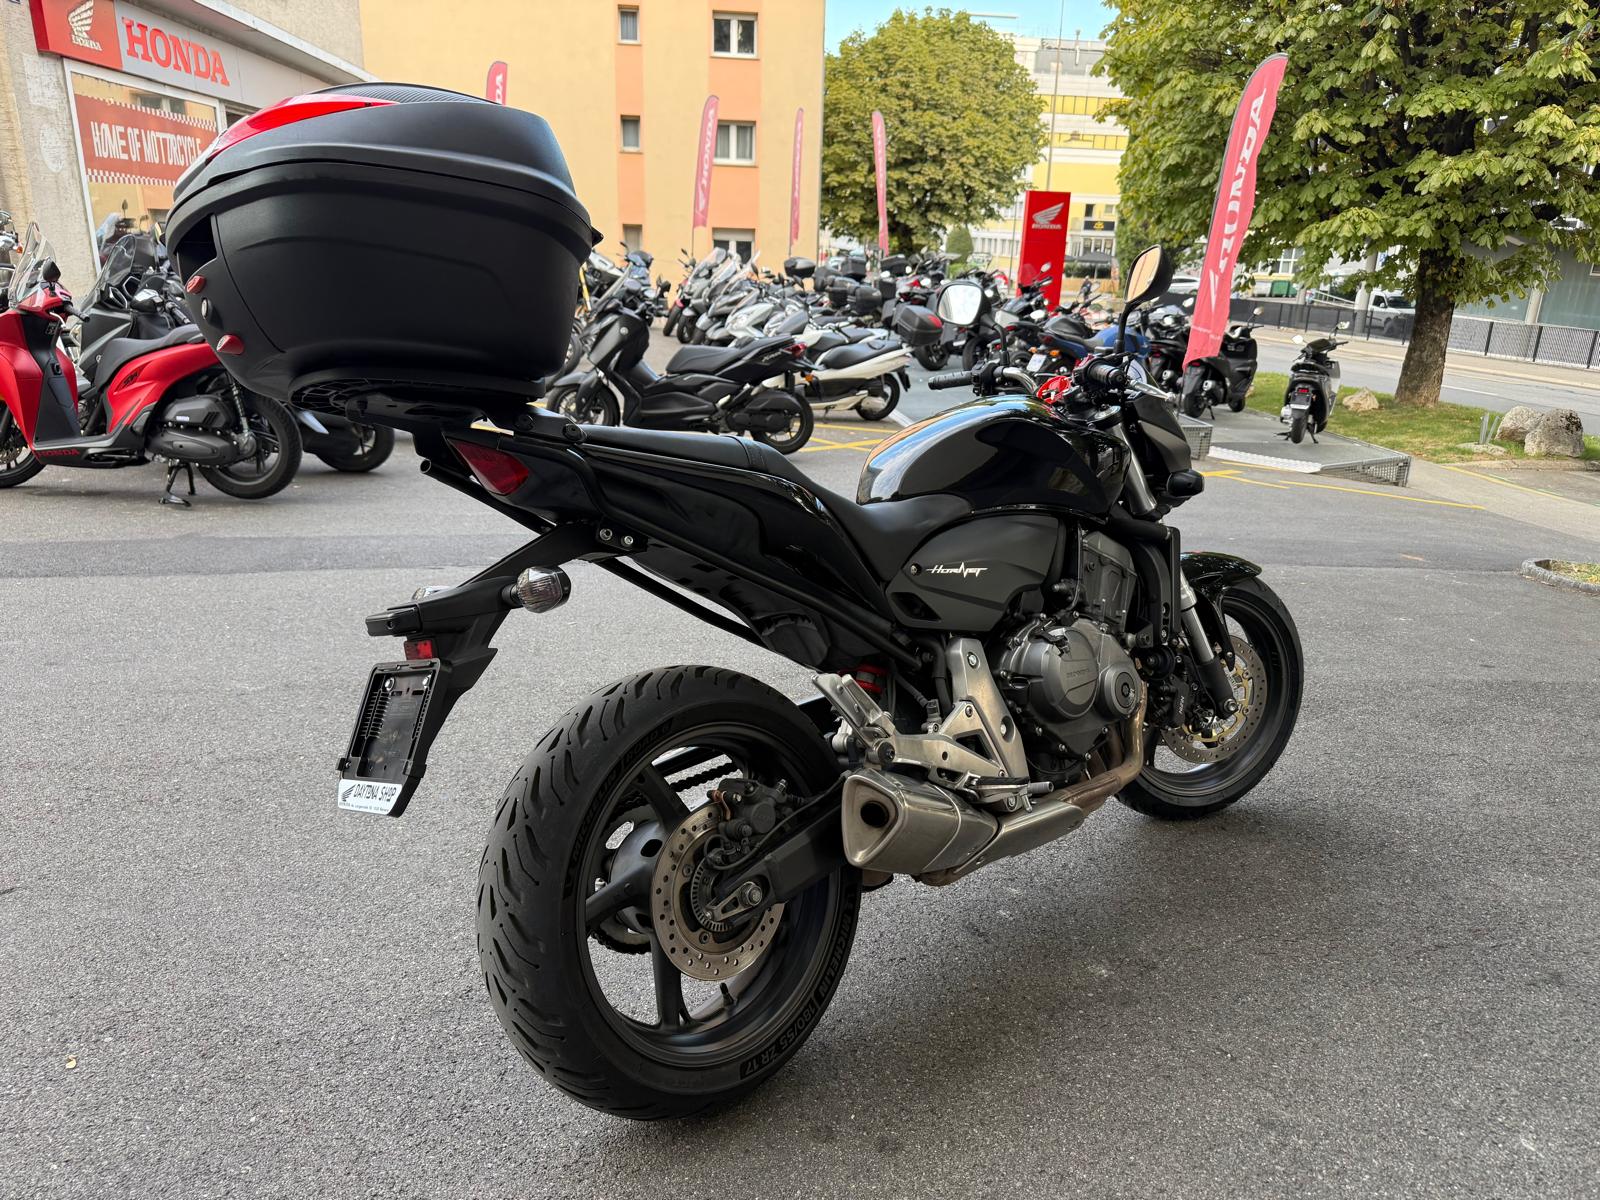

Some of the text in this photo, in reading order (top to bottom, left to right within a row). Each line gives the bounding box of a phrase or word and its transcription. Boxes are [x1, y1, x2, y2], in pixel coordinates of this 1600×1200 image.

[122, 17, 230, 87] HONDA
[91, 121, 128, 160] HOME
[127, 126, 141, 162] OF
[1219, 88, 1267, 275] HONDA
[353, 784, 397, 802] DAYTONA SHOP
[818, 913, 853, 998] MICHELIN
[780, 1004, 817, 1049] 180/55
